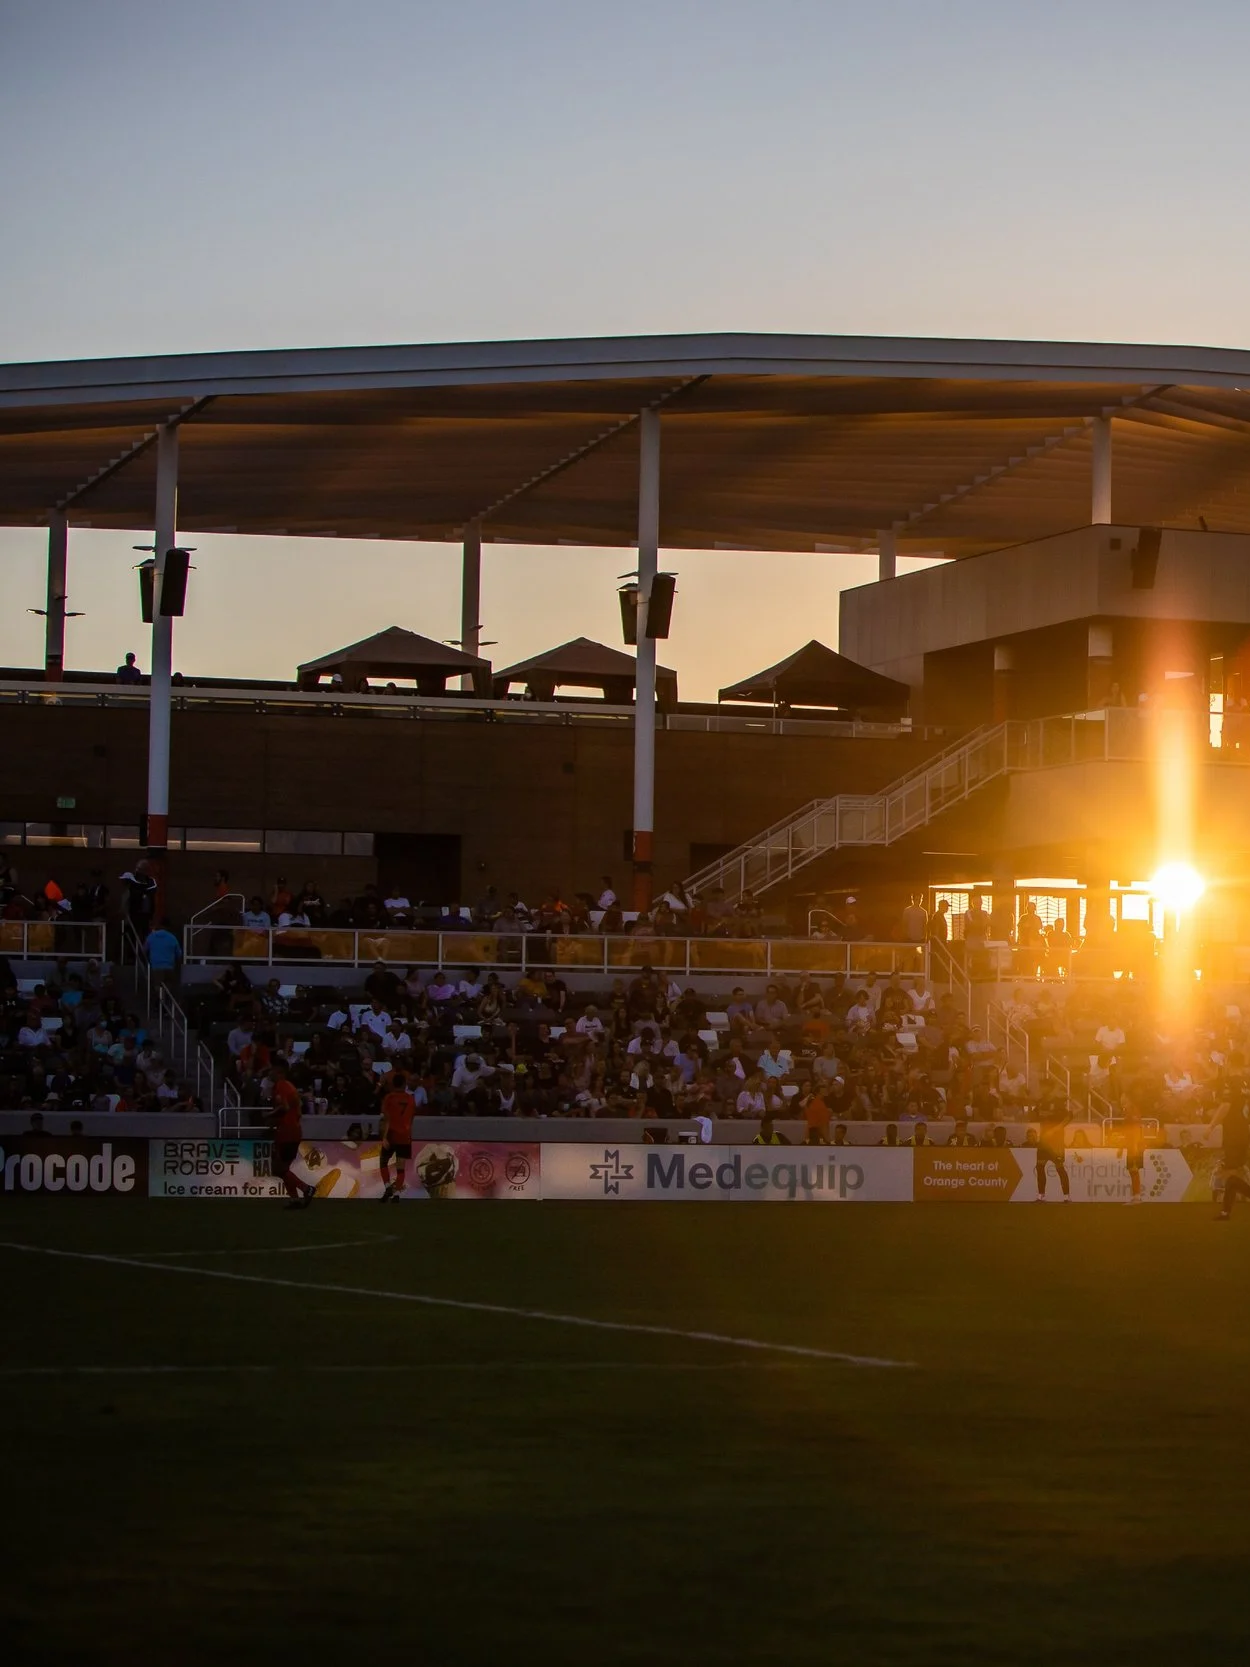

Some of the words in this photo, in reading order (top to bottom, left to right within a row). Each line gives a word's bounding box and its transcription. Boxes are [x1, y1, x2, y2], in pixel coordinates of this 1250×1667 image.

[164, 1142, 239, 1158] BRAVE
[0, 1143, 135, 1192] rocode
[164, 1160, 239, 1175] ROBOT
[933, 1160, 952, 1171] The
[955, 1160, 984, 1171] heart
[988, 1160, 999, 1171] of
[647, 1153, 864, 1197] Medequip
[923, 1176, 965, 1188] Orange
[968, 1176, 1008, 1188] County
[164, 1182, 185, 1195] Ice
[189, 1185, 236, 1195] cream
[242, 1182, 264, 1195] for
